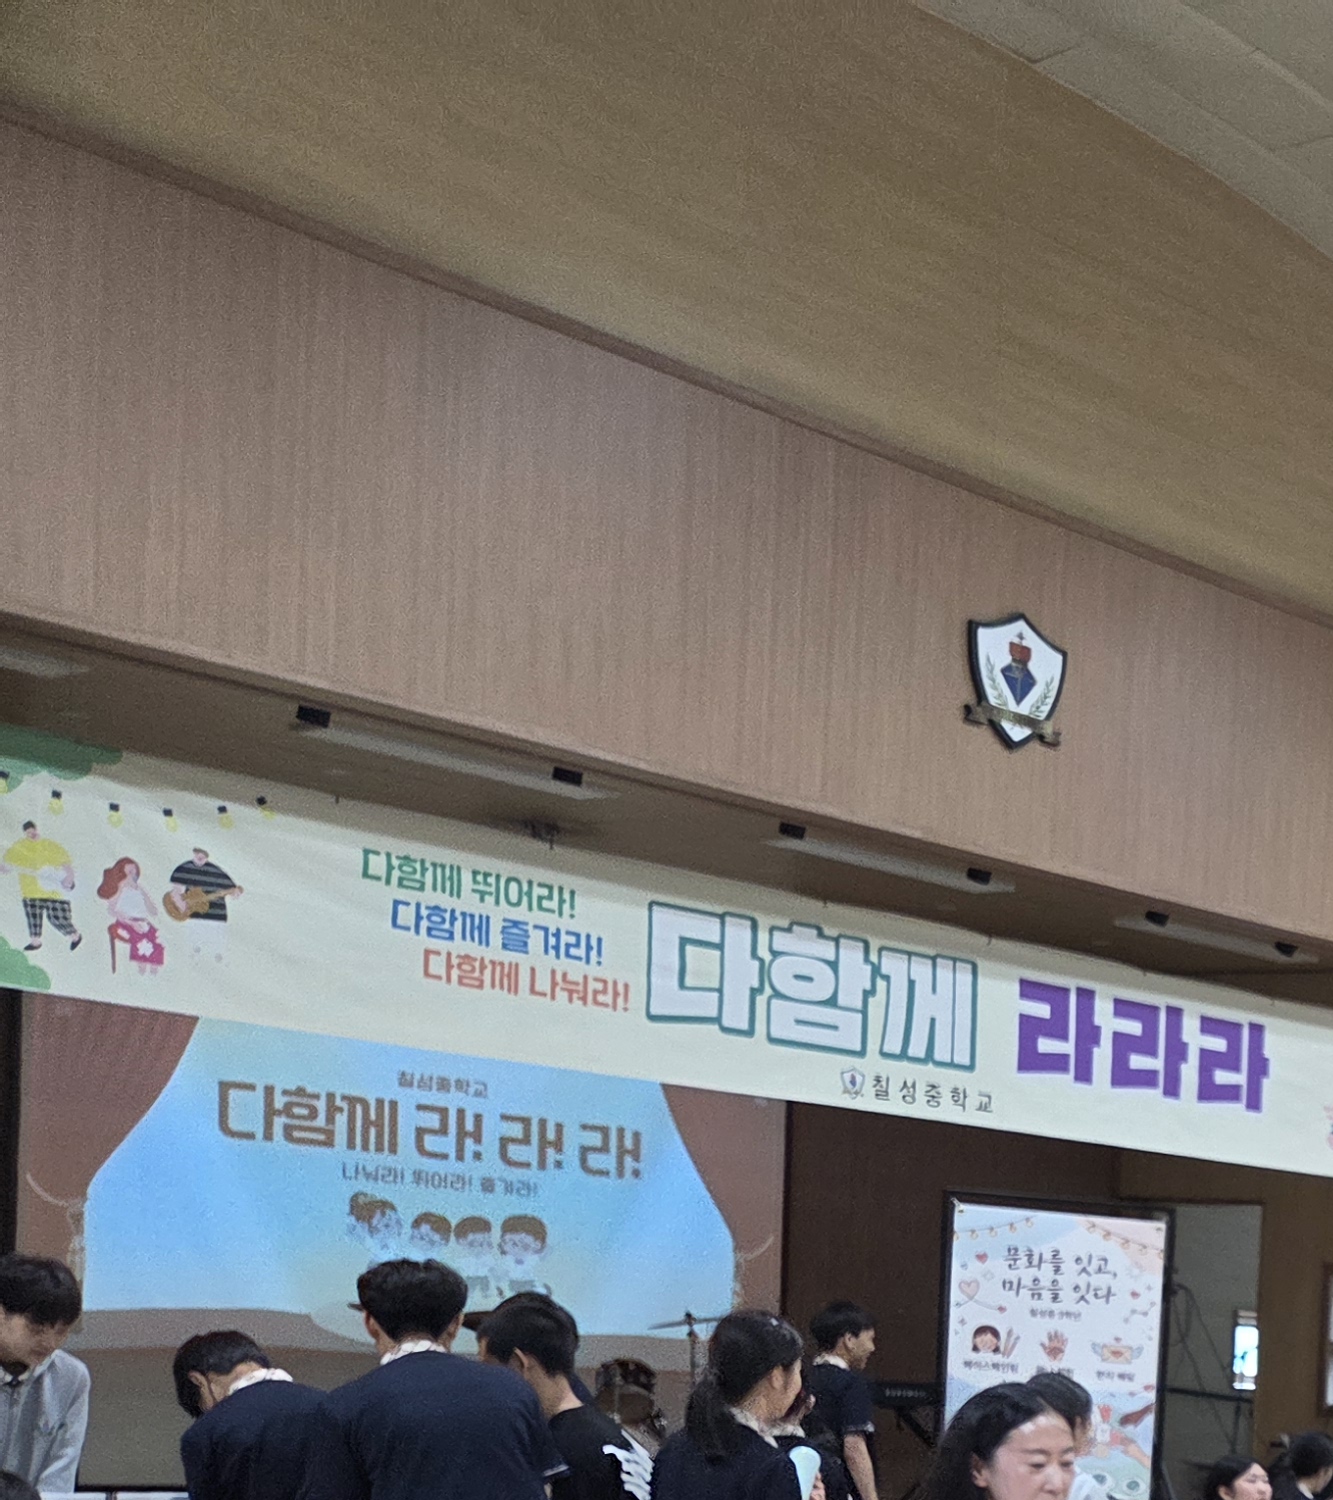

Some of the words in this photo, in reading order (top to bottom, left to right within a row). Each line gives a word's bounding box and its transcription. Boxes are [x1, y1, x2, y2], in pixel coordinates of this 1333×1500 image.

[362, 848, 462, 899] 다함께
[471, 868, 577, 919] 뛰어라!
[391, 898, 491, 948] 다함께
[500, 917, 603, 966] 즐겨라!
[423, 947, 520, 996] 다함께
[529, 966, 630, 1012] 나눠라!
[645, 900, 978, 1073] 다함께
[1016, 978, 1270, 1112] 라라라
[218, 1080, 398, 1155] 다함께
[872, 1074, 993, 1112] 칠성중학교
[1002, 1276, 1063, 1304] 마음을
[1073, 1281, 1117, 1305] 잇다
[1003, 1245, 1065, 1276] 문화를
[1074, 1253, 1117, 1279] 잇고,
